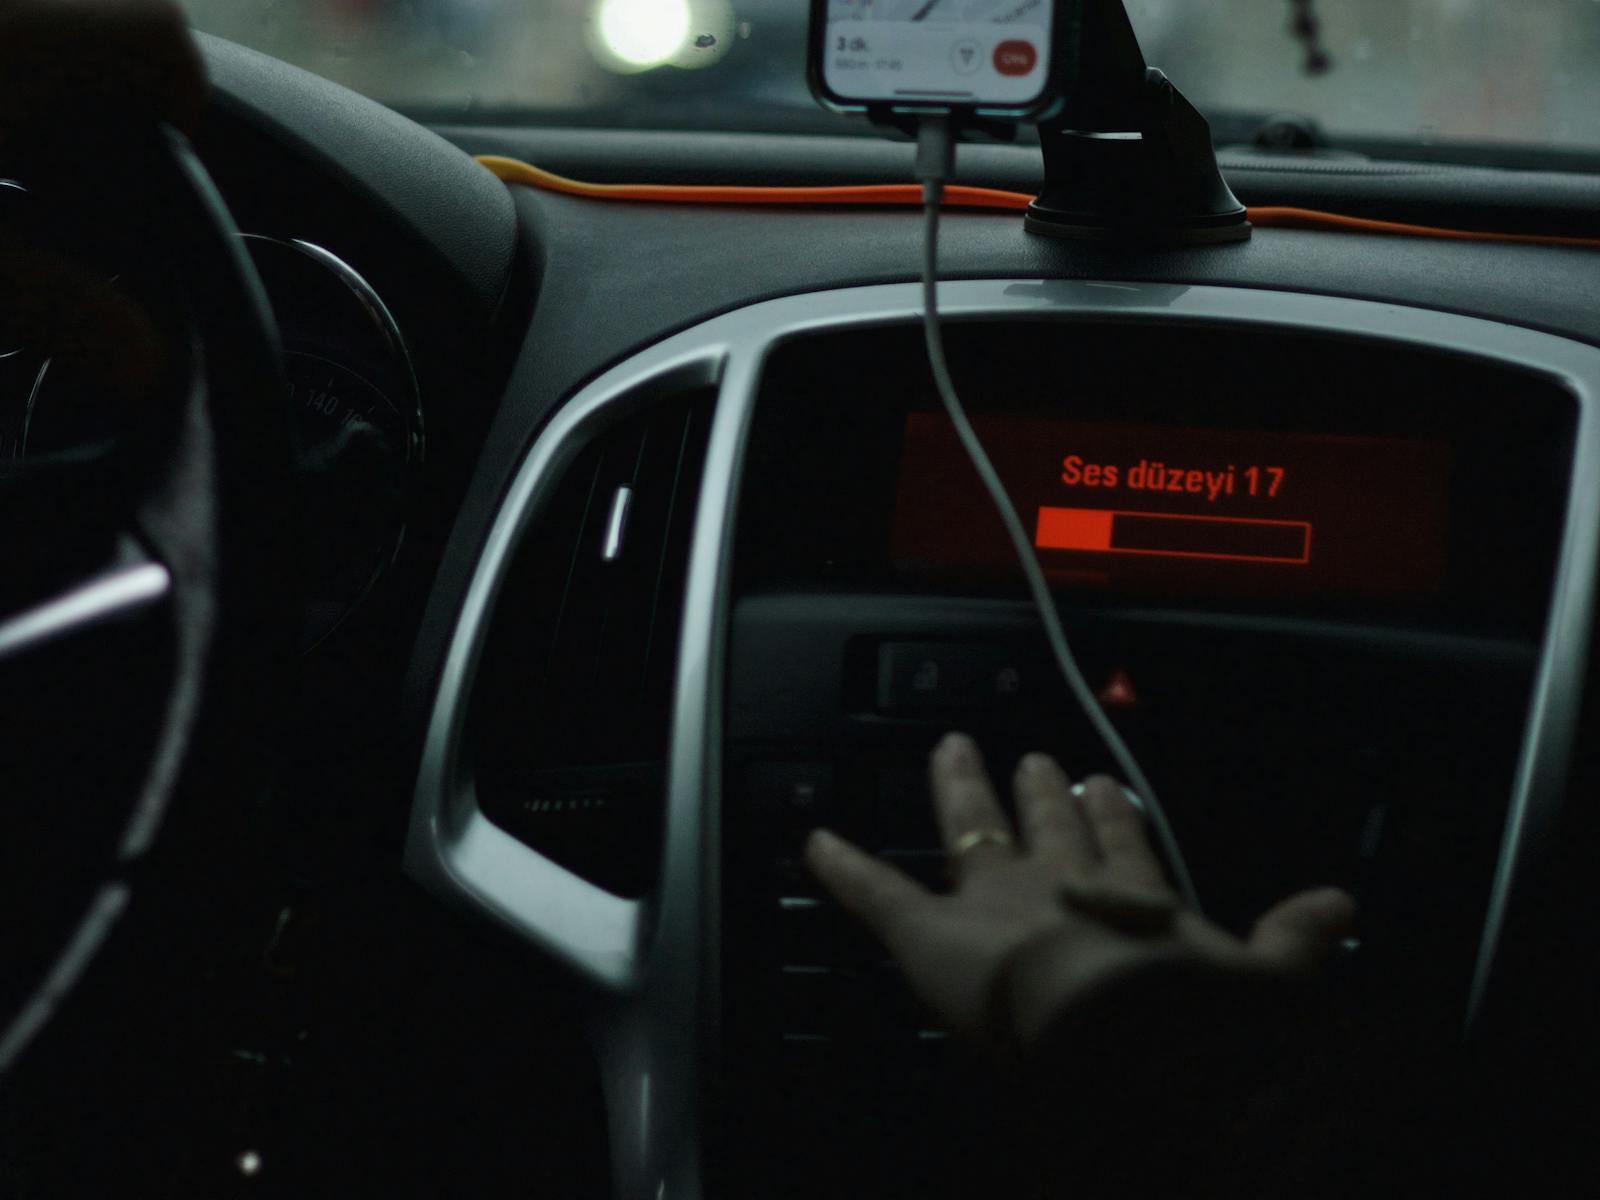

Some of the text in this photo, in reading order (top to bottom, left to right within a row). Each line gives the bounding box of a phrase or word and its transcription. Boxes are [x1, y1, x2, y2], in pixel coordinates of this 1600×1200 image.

[307, 388, 338, 416] 140
[1061, 455, 1284, 502] Ses düzeyi 17
